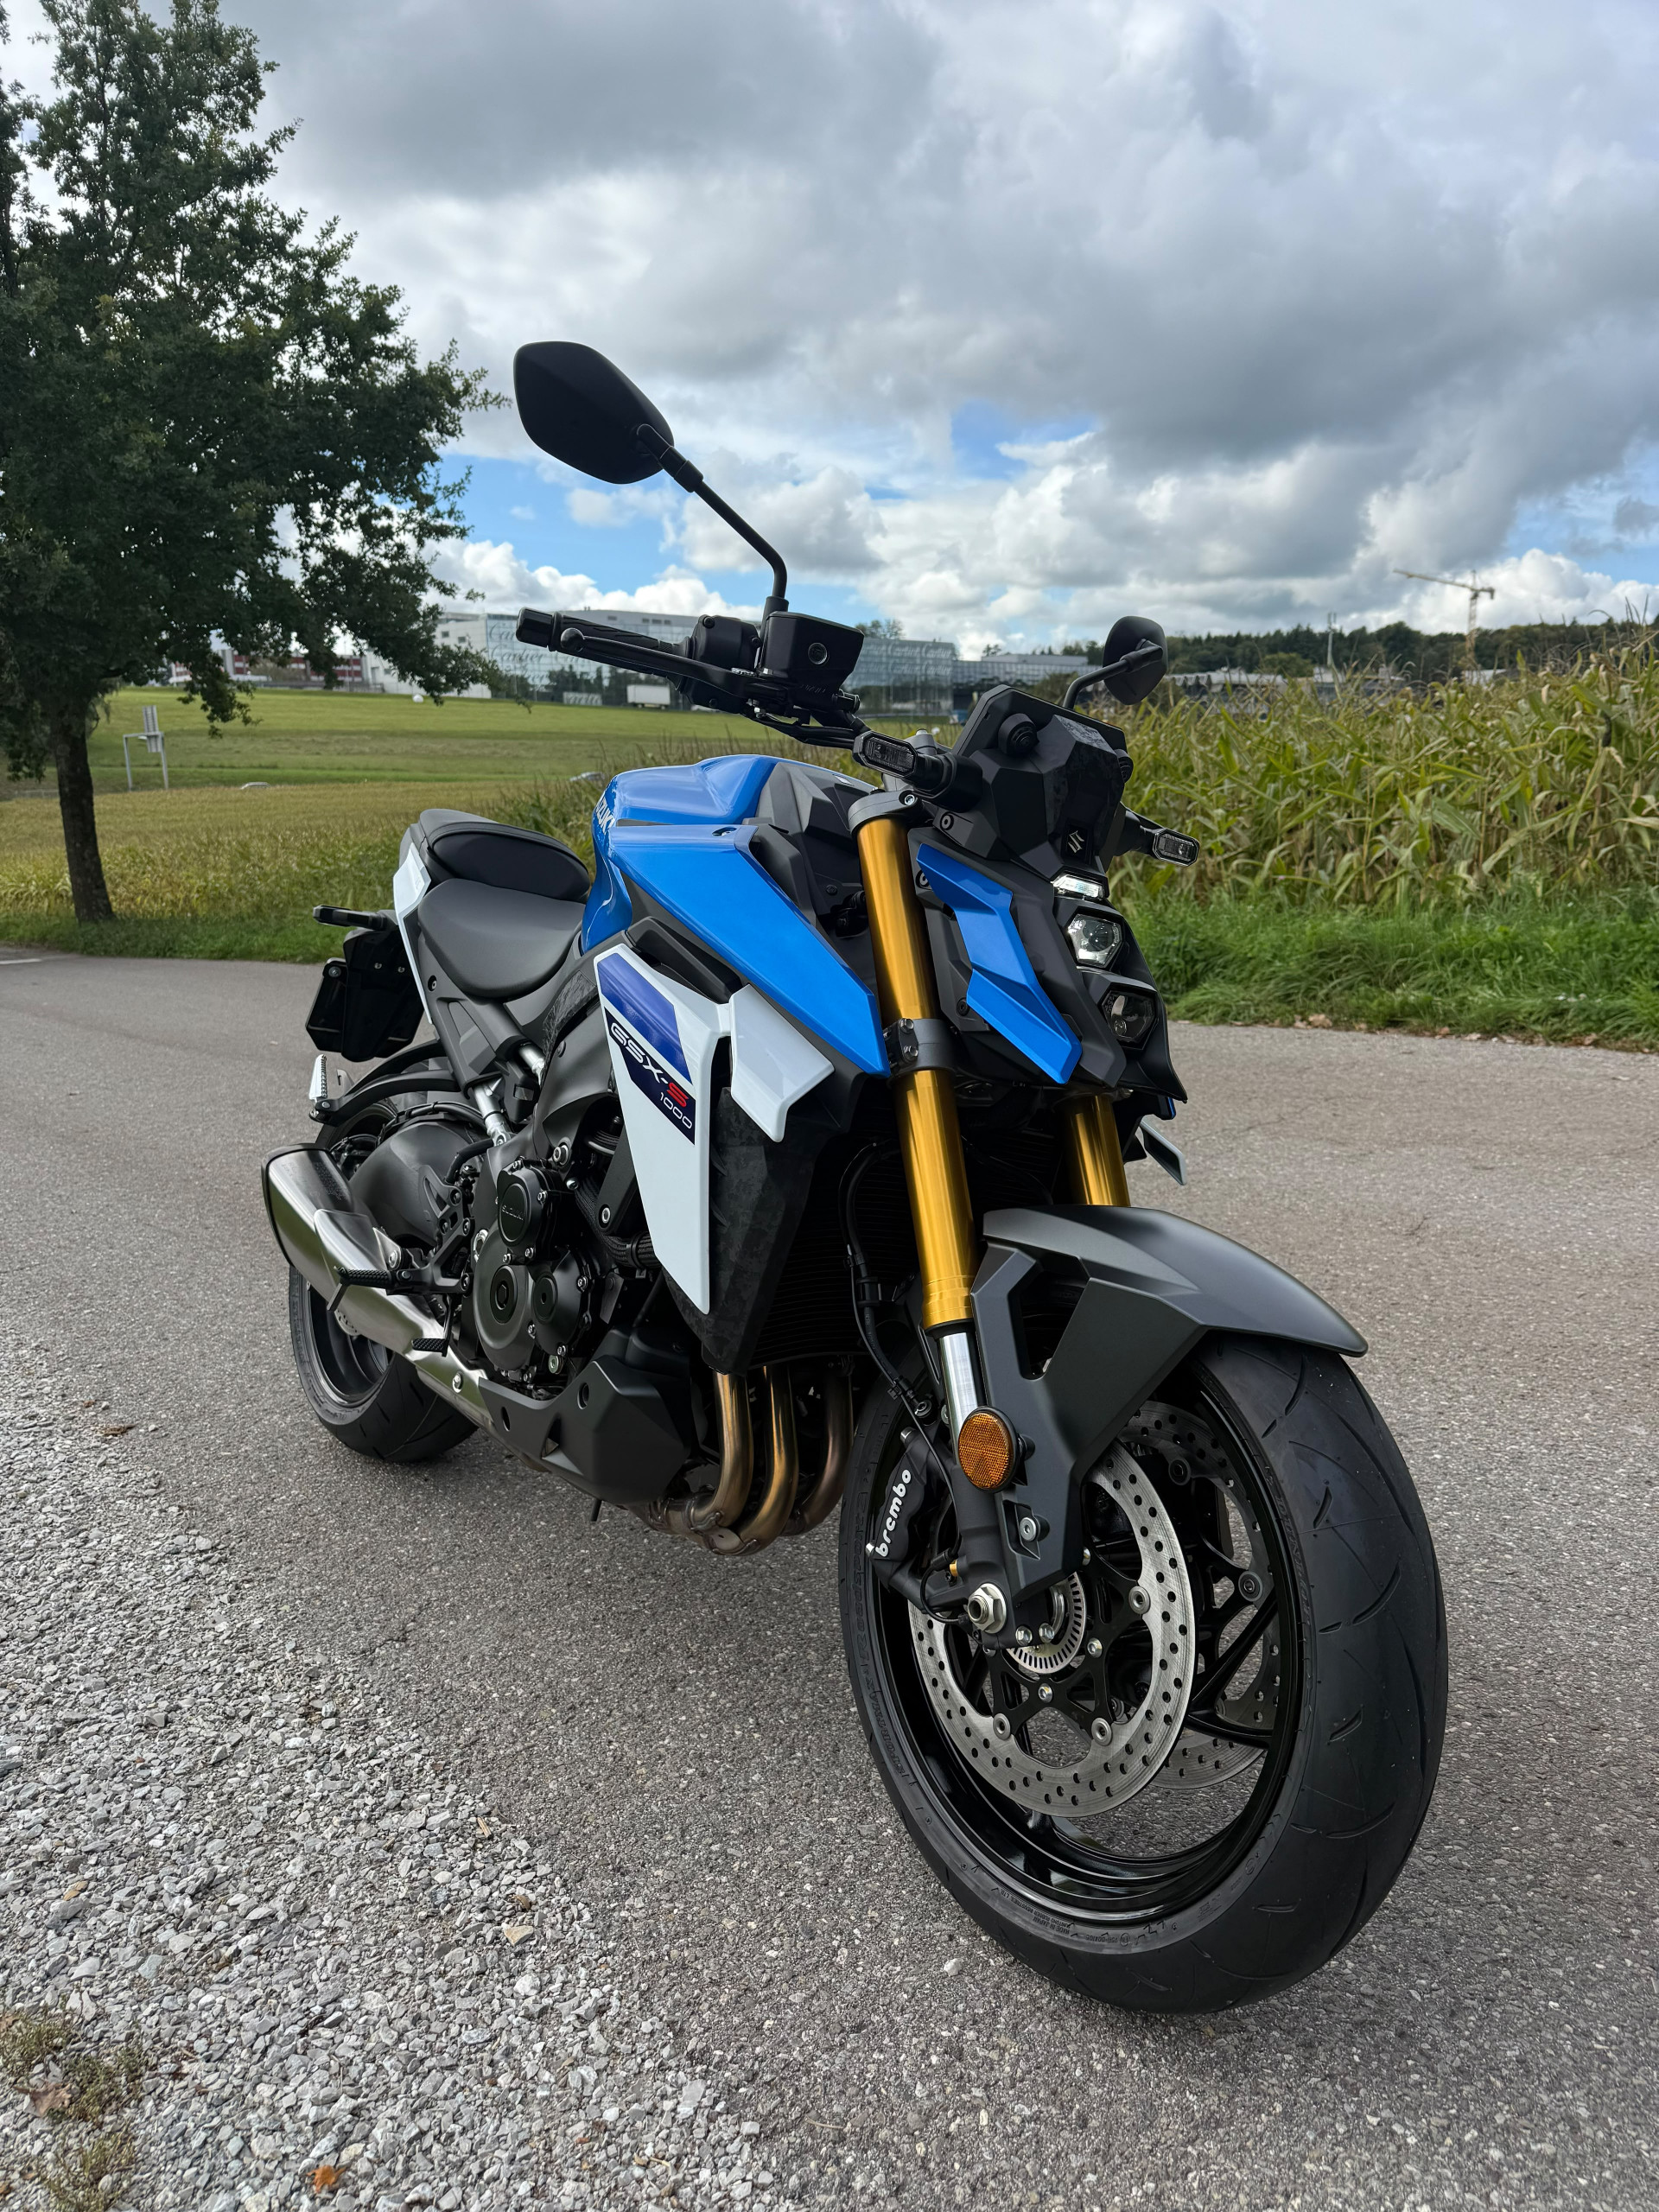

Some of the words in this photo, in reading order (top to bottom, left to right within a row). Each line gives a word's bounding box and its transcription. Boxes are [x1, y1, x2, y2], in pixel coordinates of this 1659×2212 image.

[611, 1022, 690, 1108] GSX-S
[659, 1092, 692, 1129] 1000
[875, 1470, 911, 1557] brembo
